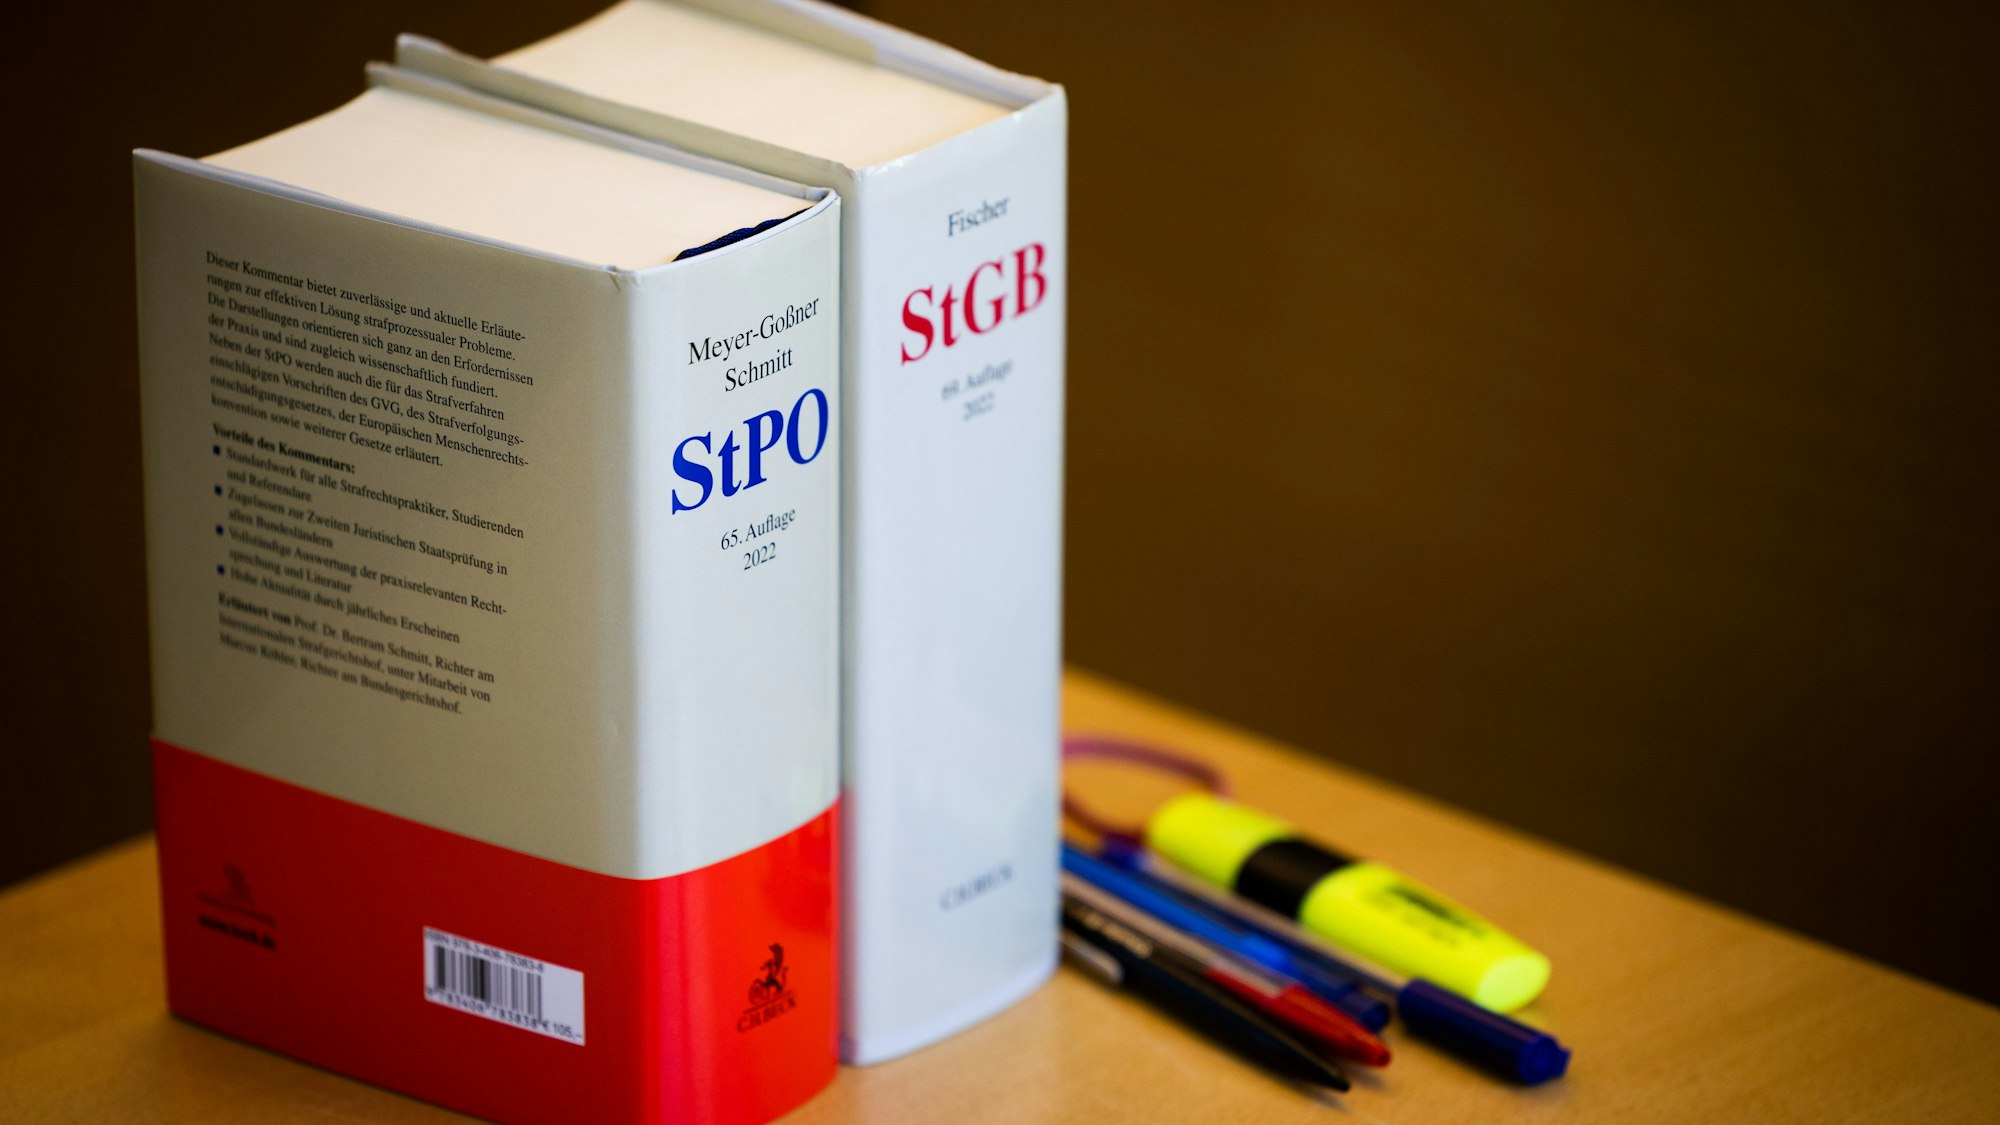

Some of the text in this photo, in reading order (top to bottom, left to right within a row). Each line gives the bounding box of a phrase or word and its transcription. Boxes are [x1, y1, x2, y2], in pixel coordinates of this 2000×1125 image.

[946, 195, 1010, 238] Fischer
[207, 252, 525, 342] Dieser Kommentar bietet zuverlässige und aktuelle Erläute-
[207, 276, 514, 360] rungen zur effektiven Lösung strafprozessualer Probleme.
[687, 298, 820, 366] Meyer-Goßner
[901, 241, 1049, 367] StGB
[208, 293, 532, 386] Die Darstellungen orientieren sich ganz an den Erfordernissen
[208, 313, 497, 398] der Praxis und sind zugleich wissenschaftlich fundiert.
[724, 346, 794, 393] Schmitt
[244, 342, 261, 358] der
[265, 347, 291, 366] StPO
[295, 358, 333, 376] werden
[337, 369, 361, 384] auch
[365, 373, 381, 389] die
[386, 378, 401, 394] für
[404, 383, 422, 399] das
[426, 388, 503, 420] Strafverfahren
[282, 372, 346, 400] Vorschriften
[350, 389, 367, 406] des
[371, 395, 402, 417] GVG,
[407, 404, 424, 420] des
[428, 410, 523, 447] Strafverfolgungs-
[257, 436, 275, 452] des
[279, 441, 354, 473] Kommentars:
[270, 413, 299, 429] sowie
[303, 422, 346, 441] weiterer
[349, 431, 391, 453] Gesetze
[395, 446, 442, 467] erläutert.
[338, 407, 355, 423] der
[359, 412, 431, 443] Europäischen
[436, 432, 528, 467] Menschenrechts-
[671, 387, 830, 515] StPO
[300, 467, 315, 483] für
[318, 474, 337, 489] alle
[340, 478, 448, 520] Strafrechtspraktiker,
[452, 508, 523, 539] Studierenden
[720, 507, 797, 552] 65. Auflage
[288, 507, 304, 520] zur
[307, 509, 350, 533] Zweiten
[353, 522, 415, 551] Juristischen
[419, 540, 493, 576] Staatsprüfung
[497, 561, 507, 576] in
[743, 542, 777, 571] 2022
